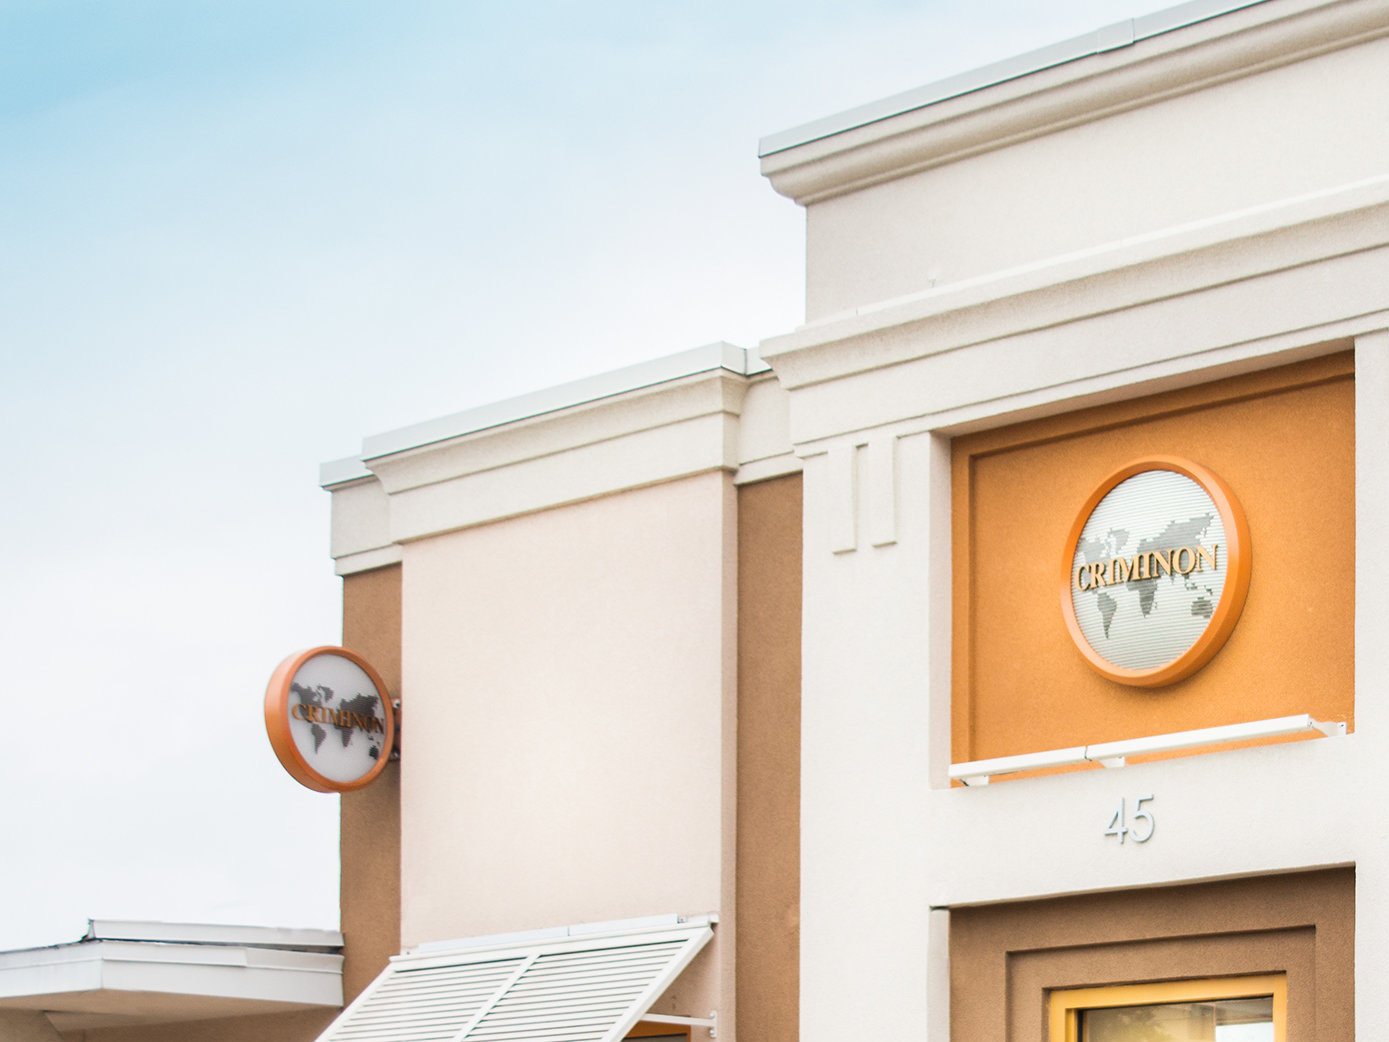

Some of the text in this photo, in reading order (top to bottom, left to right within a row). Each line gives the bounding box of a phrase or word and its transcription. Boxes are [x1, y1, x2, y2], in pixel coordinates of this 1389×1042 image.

[1076, 544, 1218, 592] CRIMINON
[292, 703, 385, 734] CRIMINON
[1104, 794, 1155, 845] 45
